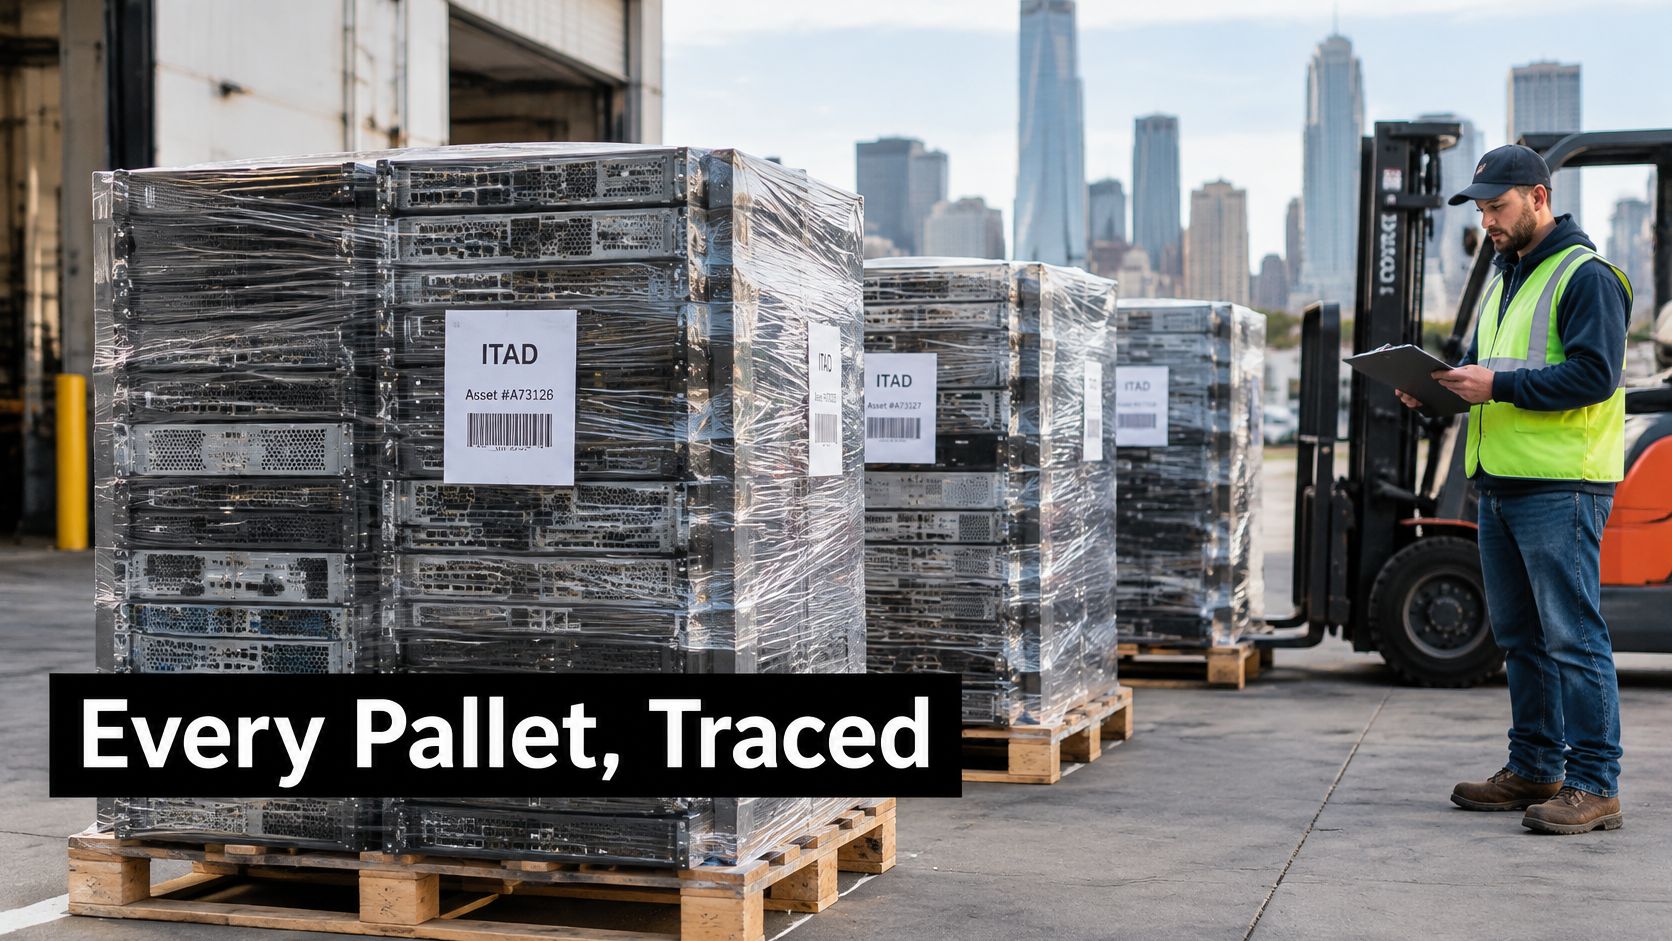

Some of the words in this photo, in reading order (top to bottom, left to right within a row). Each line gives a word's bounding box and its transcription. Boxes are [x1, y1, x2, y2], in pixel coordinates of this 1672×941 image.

[482, 343, 538, 365] ITAD
[818, 353, 833, 373] ITAD
[876, 374, 913, 388] ITAD
[1124, 381, 1151, 392] ITAD
[465, 389, 498, 401] Asset
[501, 389, 554, 401] #A73126
[867, 402, 887, 410] Asset
